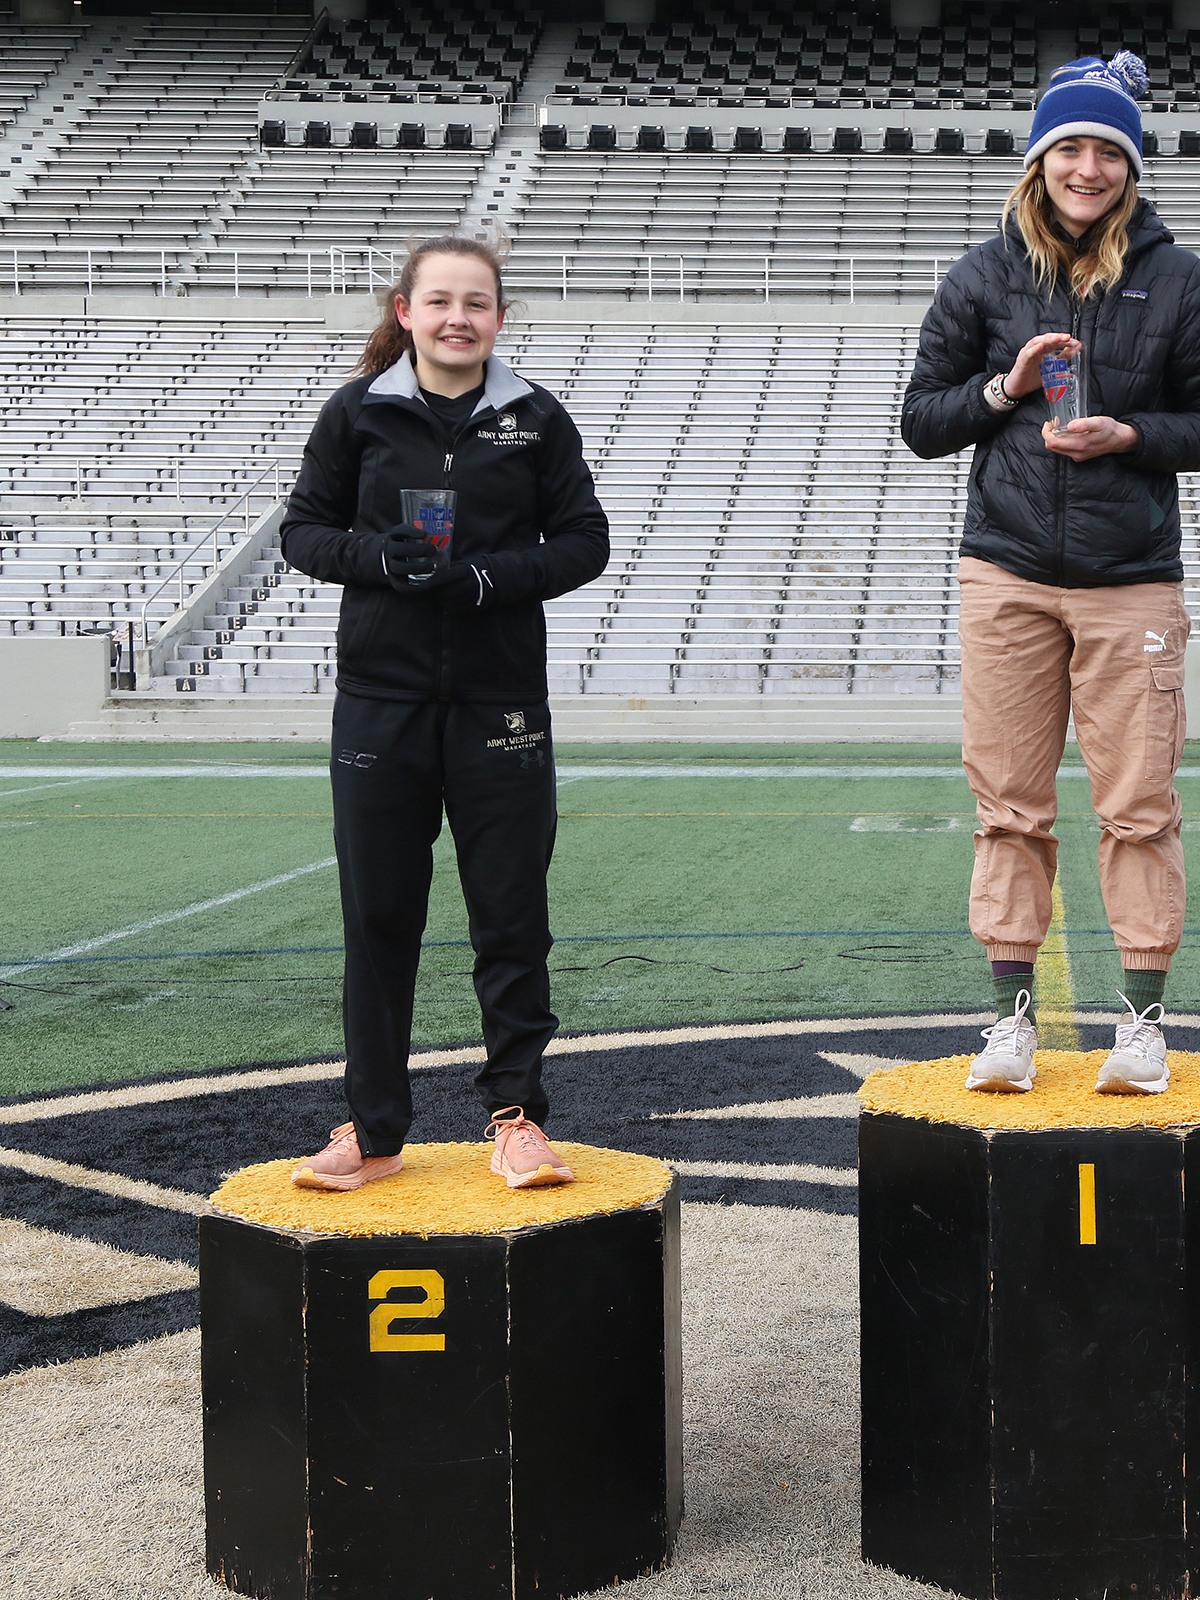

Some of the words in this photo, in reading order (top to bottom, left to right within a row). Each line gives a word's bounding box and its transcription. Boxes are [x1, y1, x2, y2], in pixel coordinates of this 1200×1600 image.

[477, 430, 496, 439] ARMY
[497, 431, 518, 440] WEST
[519, 431, 539, 440] POINT
[279, 562, 287, 573] J
[267, 575, 276, 587] H
[256, 588, 266, 600] G
[233, 616, 241, 629] E
[221, 631, 230, 644] D
[208, 647, 217, 659] C
[1143, 644, 1163, 653] PUMA
[194, 662, 205, 675] B
[182, 678, 191, 691] A
[486, 739, 507, 748] ARMY
[508, 735, 528, 745] WEST
[528, 732, 545, 742] POINT
[367, 1269, 446, 1353] 2
